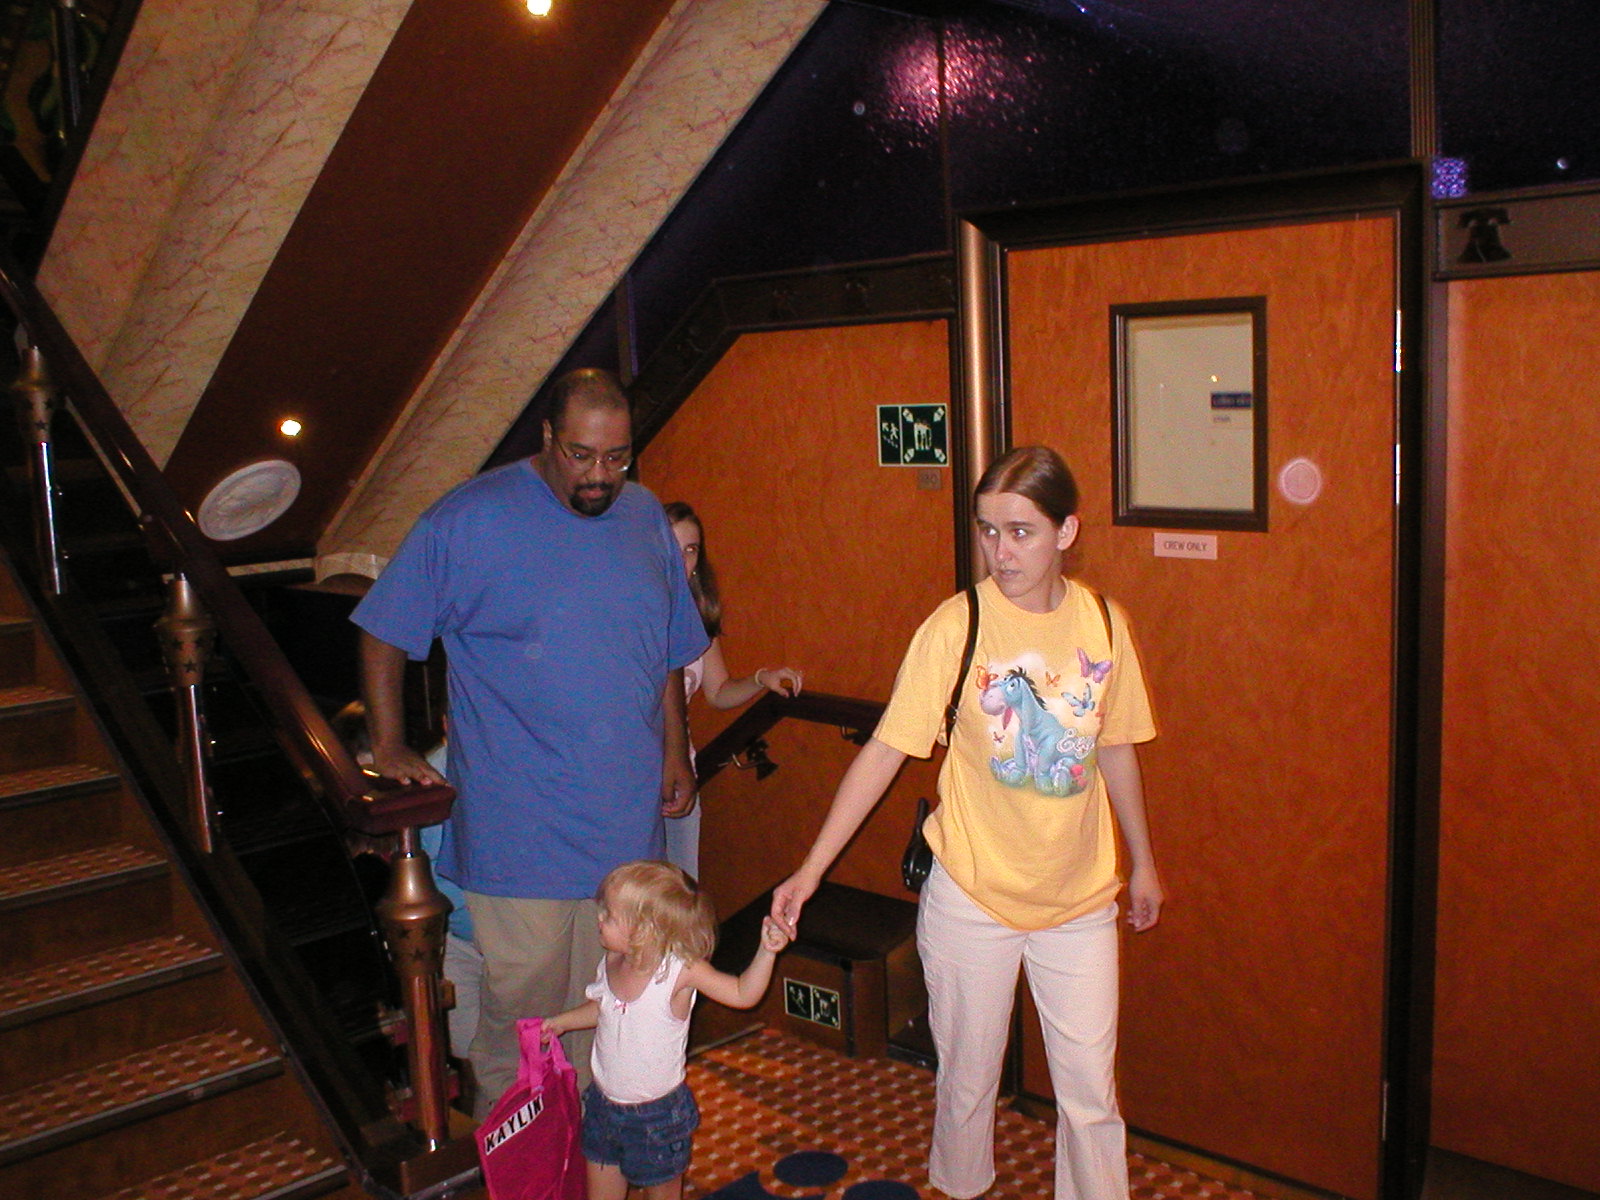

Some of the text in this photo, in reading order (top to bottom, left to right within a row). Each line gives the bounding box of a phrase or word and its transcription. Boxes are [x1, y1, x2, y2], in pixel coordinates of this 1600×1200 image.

[1163, 541, 1207, 552] CREW ONLY
[486, 1095, 542, 1152] KAYLIN
